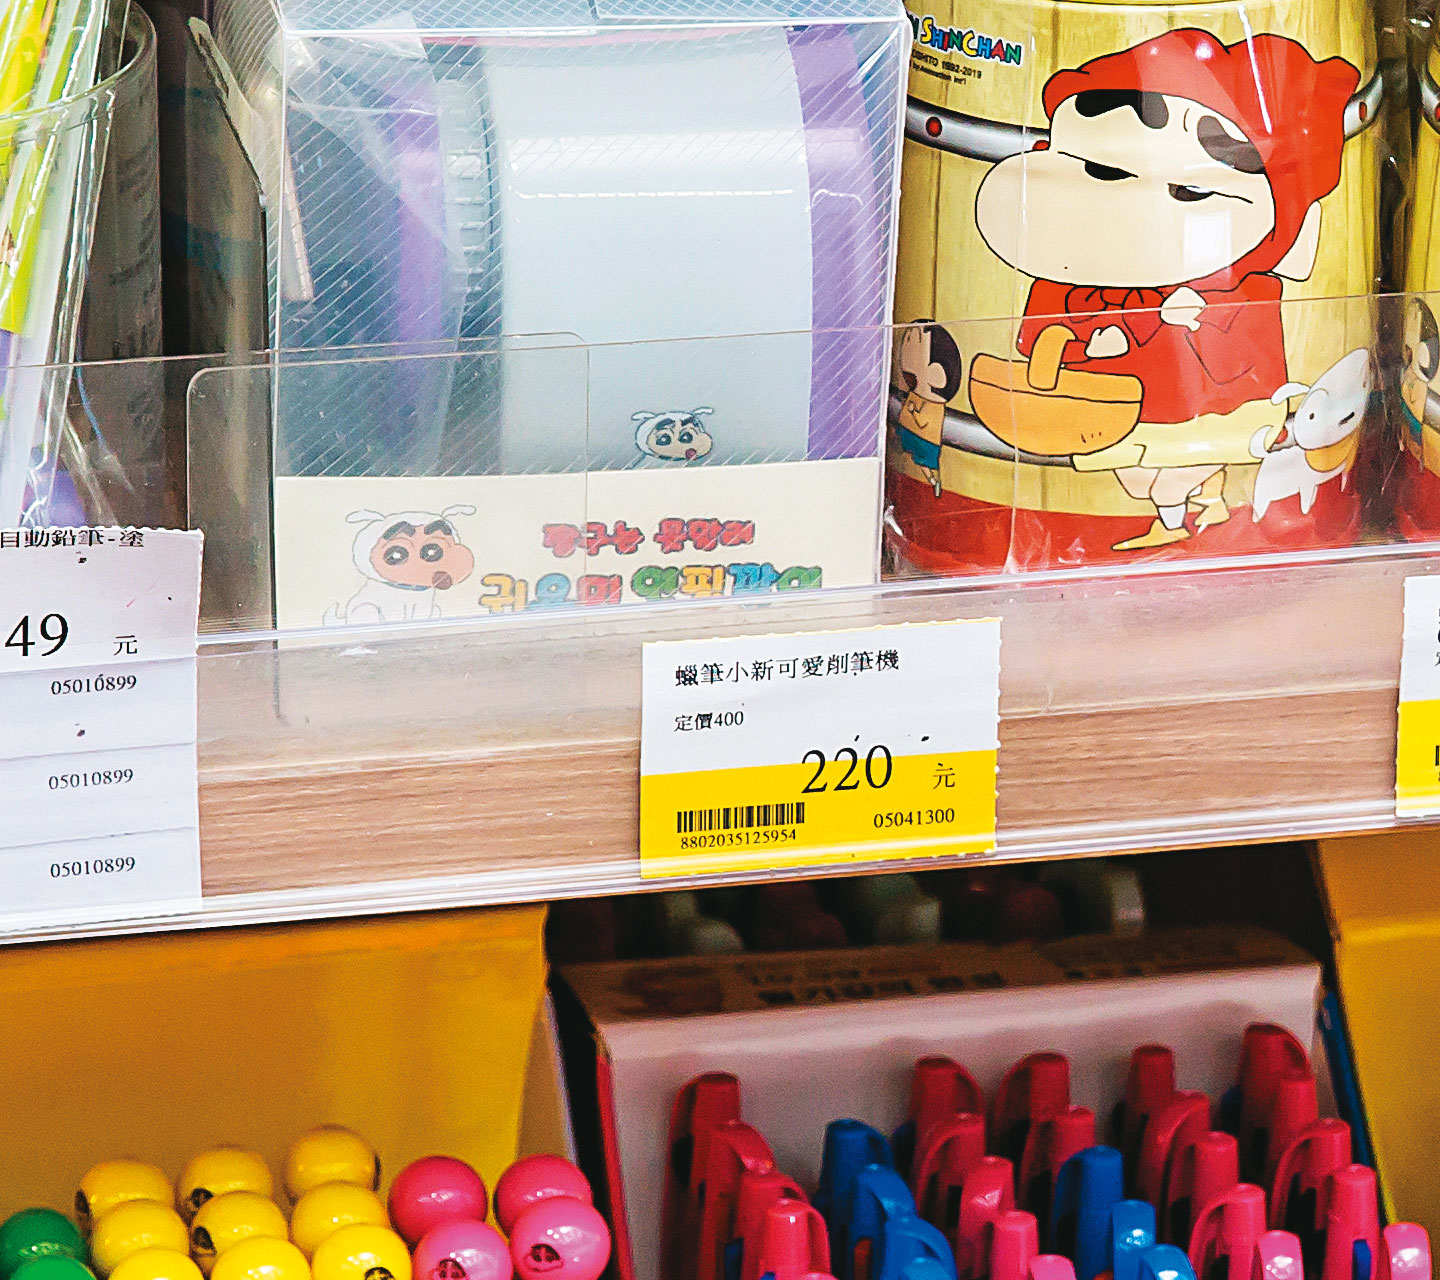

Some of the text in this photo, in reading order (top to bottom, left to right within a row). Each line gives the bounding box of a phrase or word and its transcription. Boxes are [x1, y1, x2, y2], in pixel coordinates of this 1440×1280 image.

[921, 17, 1022, 66] SHINCHAN
[5, 613, 138, 659] 49 元
[675, 649, 899, 689] 蠟筆小新可愛削筆機
[50, 675, 137, 696] 05010899
[674, 710, 744, 733] 定價400
[48, 769, 135, 791] 05010899
[801, 744, 956, 795] 220 元
[873, 808, 955, 830] 05041300
[681, 829, 797, 850] 8802035125954
[49, 857, 136, 880] 05010899
